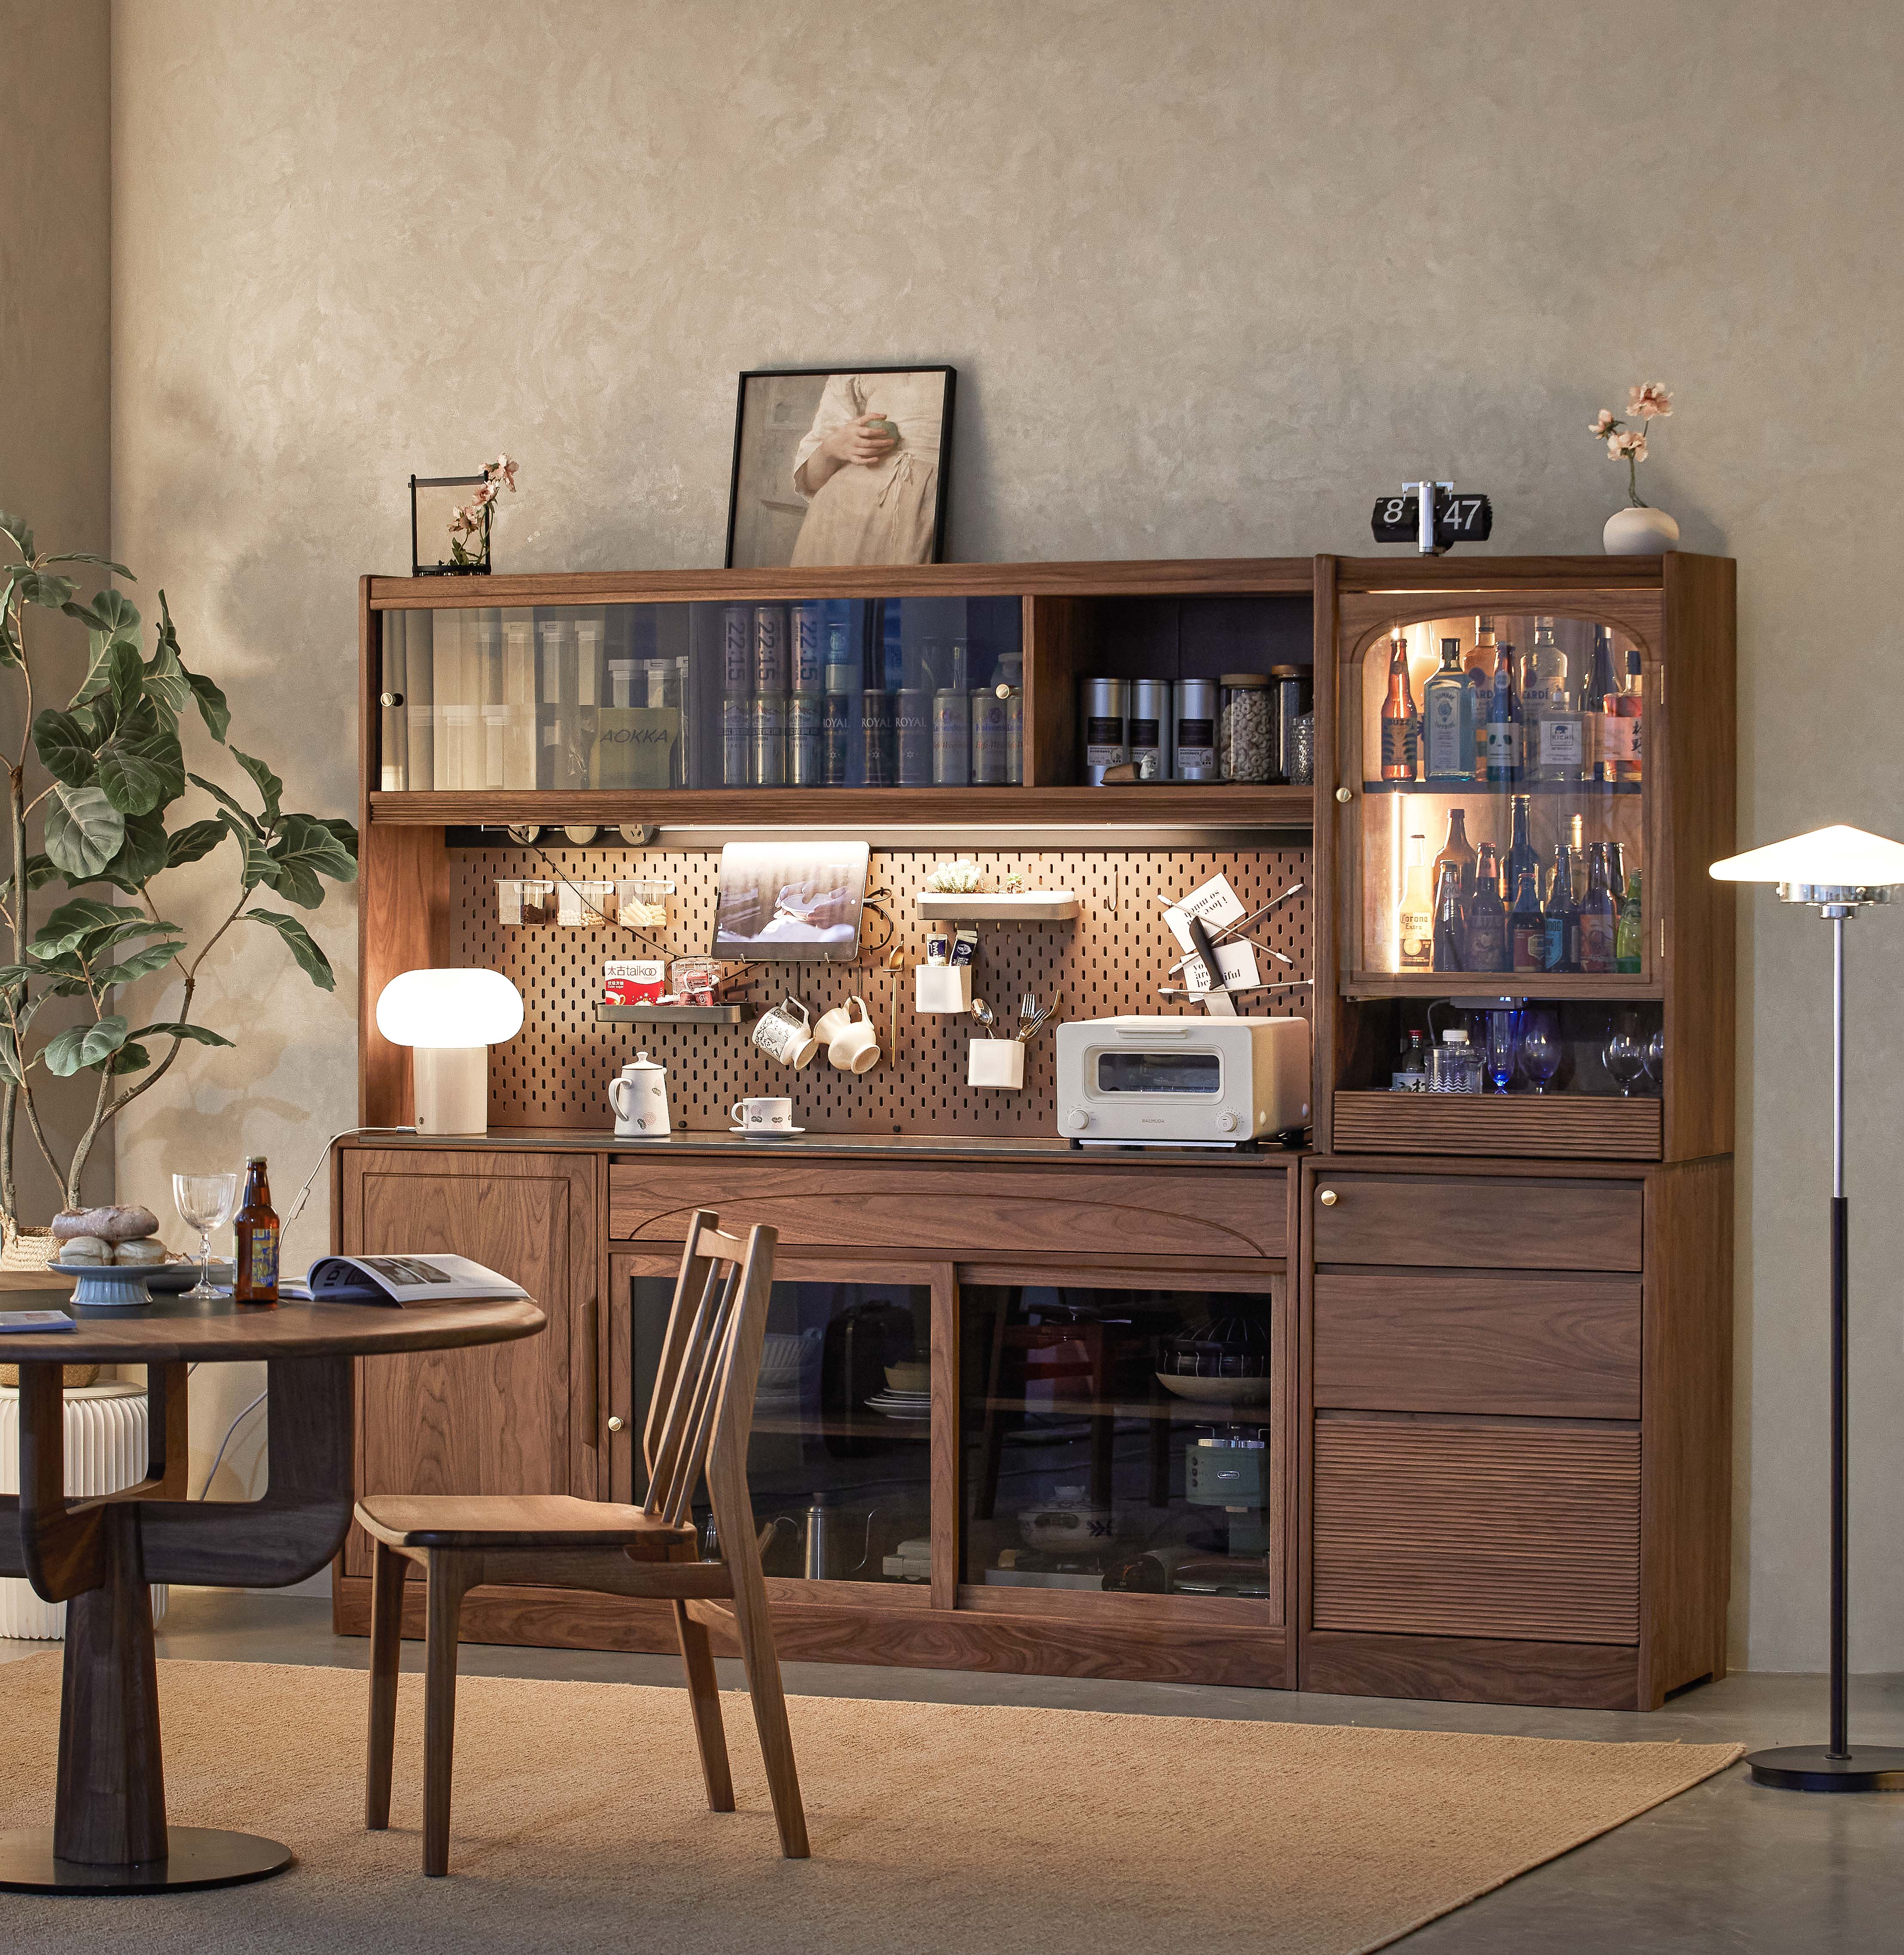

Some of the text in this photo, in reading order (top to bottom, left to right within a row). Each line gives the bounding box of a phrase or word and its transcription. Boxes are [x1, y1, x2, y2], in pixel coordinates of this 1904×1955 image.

[1383, 499, 1481, 530] 8 47
[728, 622, 746, 680] 22:15
[759, 621, 775, 680] 22:15
[800, 621, 818, 680] 22:15
[862, 717, 893, 728] ROYAL
[895, 717, 926, 727] ROYAL
[600, 729, 667, 743] AOKKA
[1210, 890, 1220, 899] so
[1203, 900, 1222, 915] love
[1400, 914, 1428, 924] Corona
[1193, 964, 1203, 973] yo
